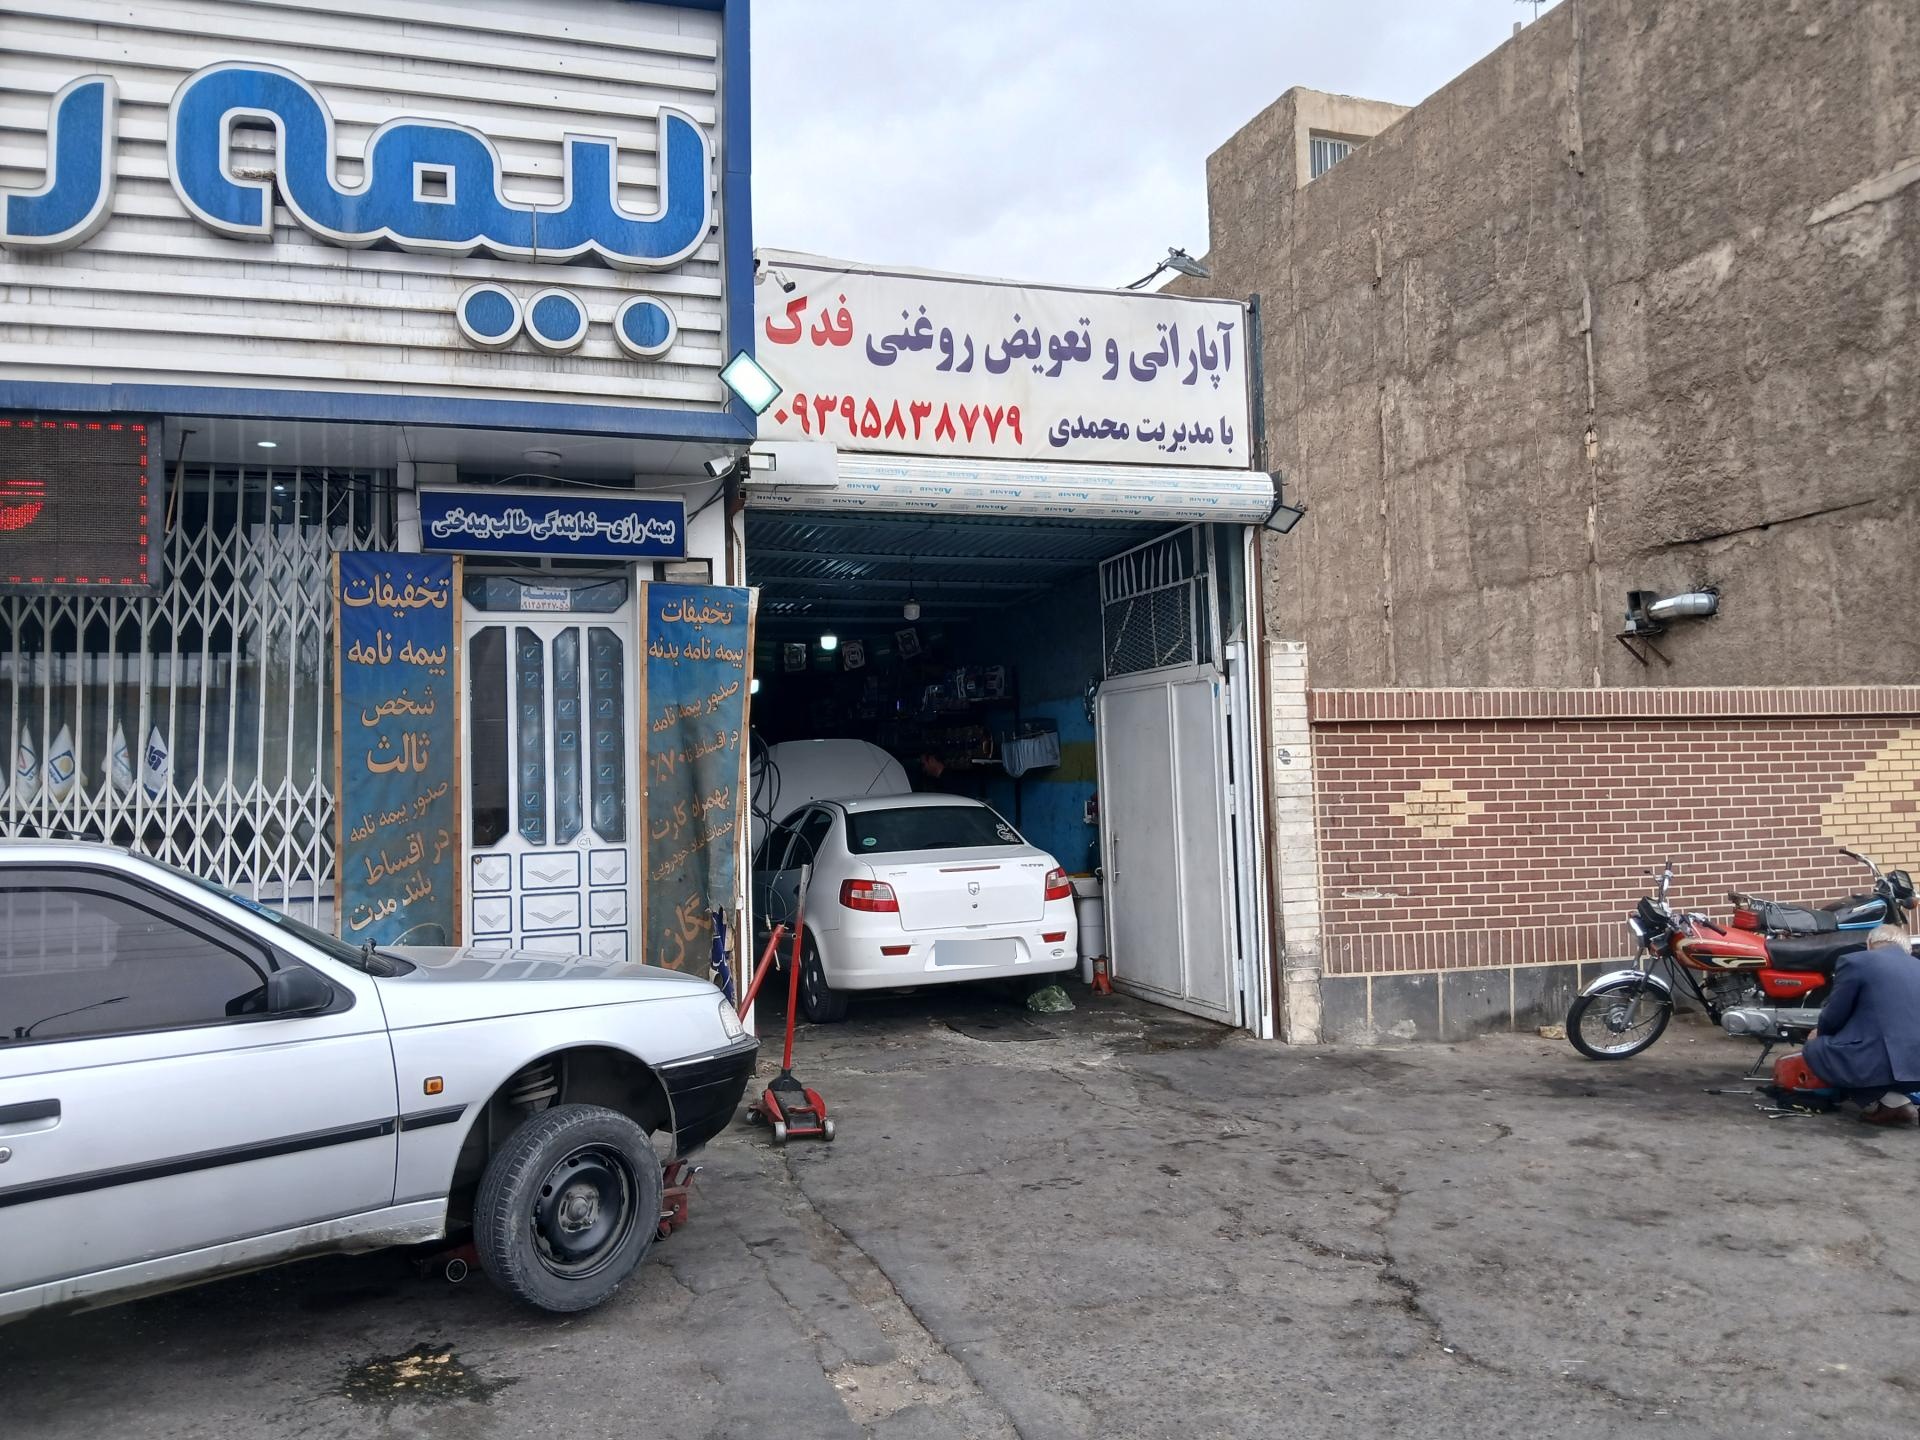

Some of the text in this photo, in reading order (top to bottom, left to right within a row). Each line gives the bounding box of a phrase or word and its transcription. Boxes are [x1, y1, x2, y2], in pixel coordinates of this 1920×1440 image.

[168, 60, 714, 361] بیمه
[764, 293, 1235, 390] آپاراتی و تعویض روغنی فدک
[774, 392, 1234, 454] با مدیریت محمدی ۰۹۳۹۵۸۳۸۷۷۹
[431, 507, 489, 539] بیدختی
[489, 507, 532, 538] طالب
[647, 518, 676, 544] بیمه
[343, 571, 450, 618] تخفیفات
[661, 596, 734, 631] تخفیفات
[347, 628, 447, 676] بیمه نامه
[648, 636, 745, 669] بیمه نامه بدنه
[361, 685, 436, 728] شخص
[652, 680, 740, 733] صدور بیمه نامه
[366, 731, 431, 774] ثالث
[695, 731, 727, 760] اقساط
[730, 730, 739, 751] در
[350, 781, 449, 843] صدور بیمه نامه
[652, 785, 731, 841] بهمراه کارت
[706, 818, 734, 842] خدمات
[365, 827, 450, 886] در اقساط
[349, 869, 435, 933] بلند مدت
